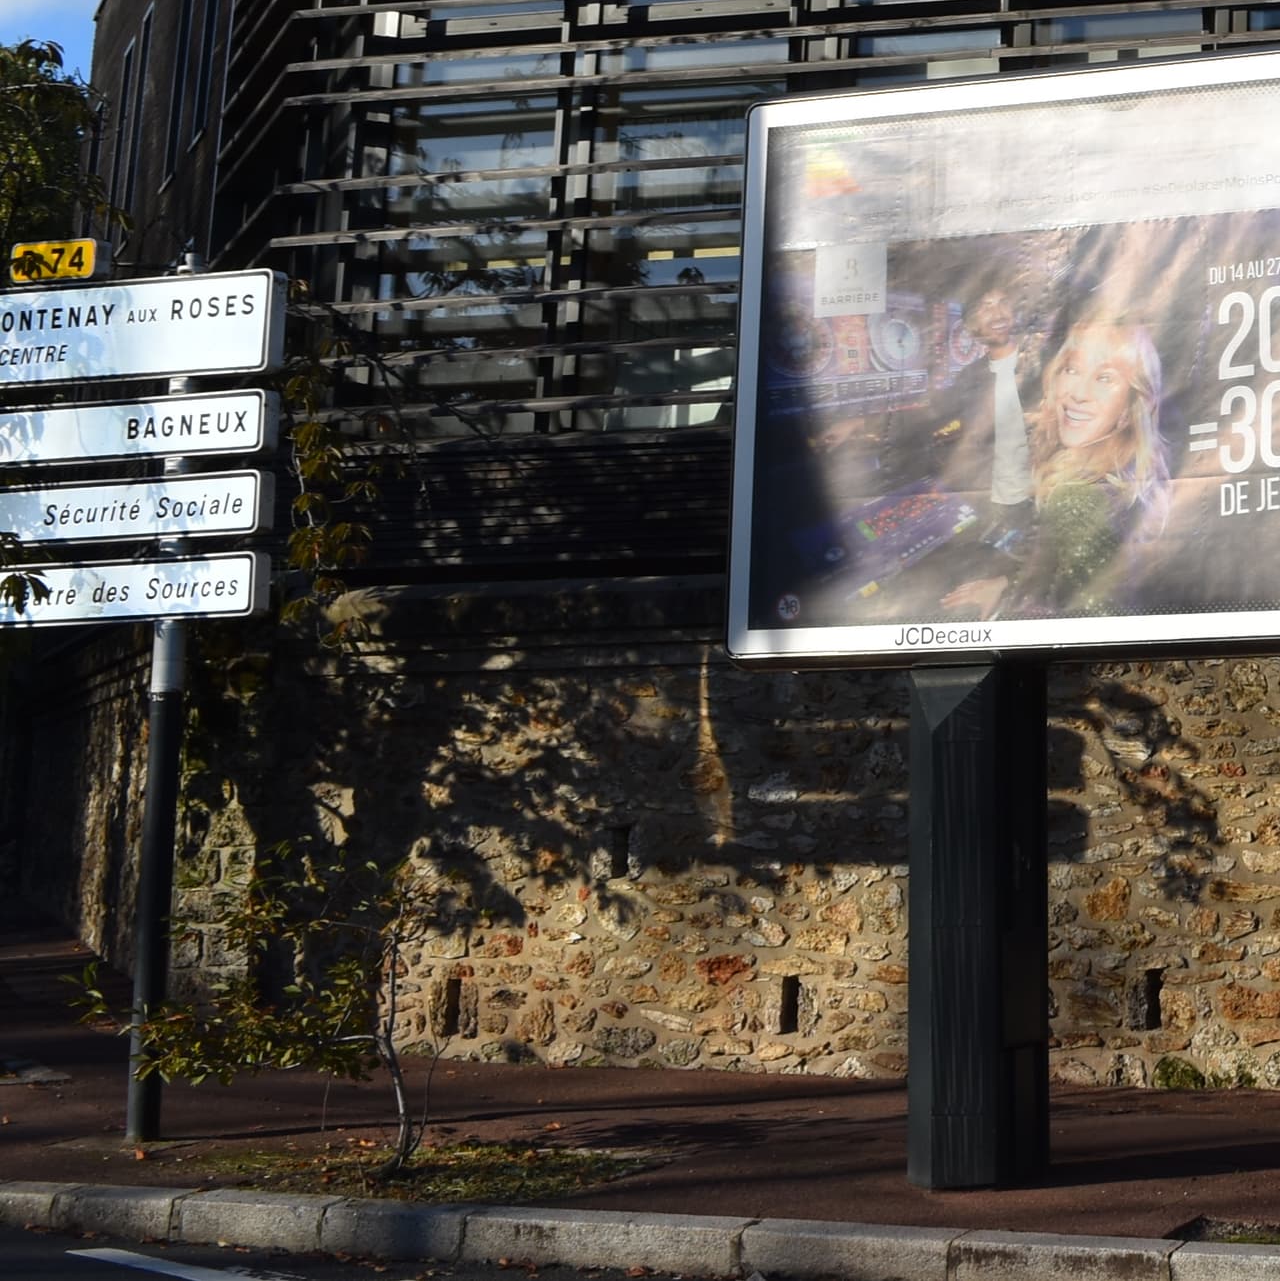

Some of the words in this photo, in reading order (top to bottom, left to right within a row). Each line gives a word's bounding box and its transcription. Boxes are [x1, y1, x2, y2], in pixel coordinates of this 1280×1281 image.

[1209, 266, 1226, 285] DU
[1231, 262, 1244, 282] 14
[1247, 260, 1264, 279] AU
[1, 304, 115, 332] ONTENAY
[126, 308, 158, 324] AUX
[171, 294, 255, 320] ROSES
[0, 344, 68, 366] CENTRE
[127, 410, 248, 440] BAGNEUX
[43, 500, 141, 526] Sécurité
[156, 493, 244, 518] Sociale
[1220, 481, 1250, 516] DE
[92, 581, 130, 604] des
[146, 578, 239, 600] Sources
[895, 627, 993, 646] JCDecaux
